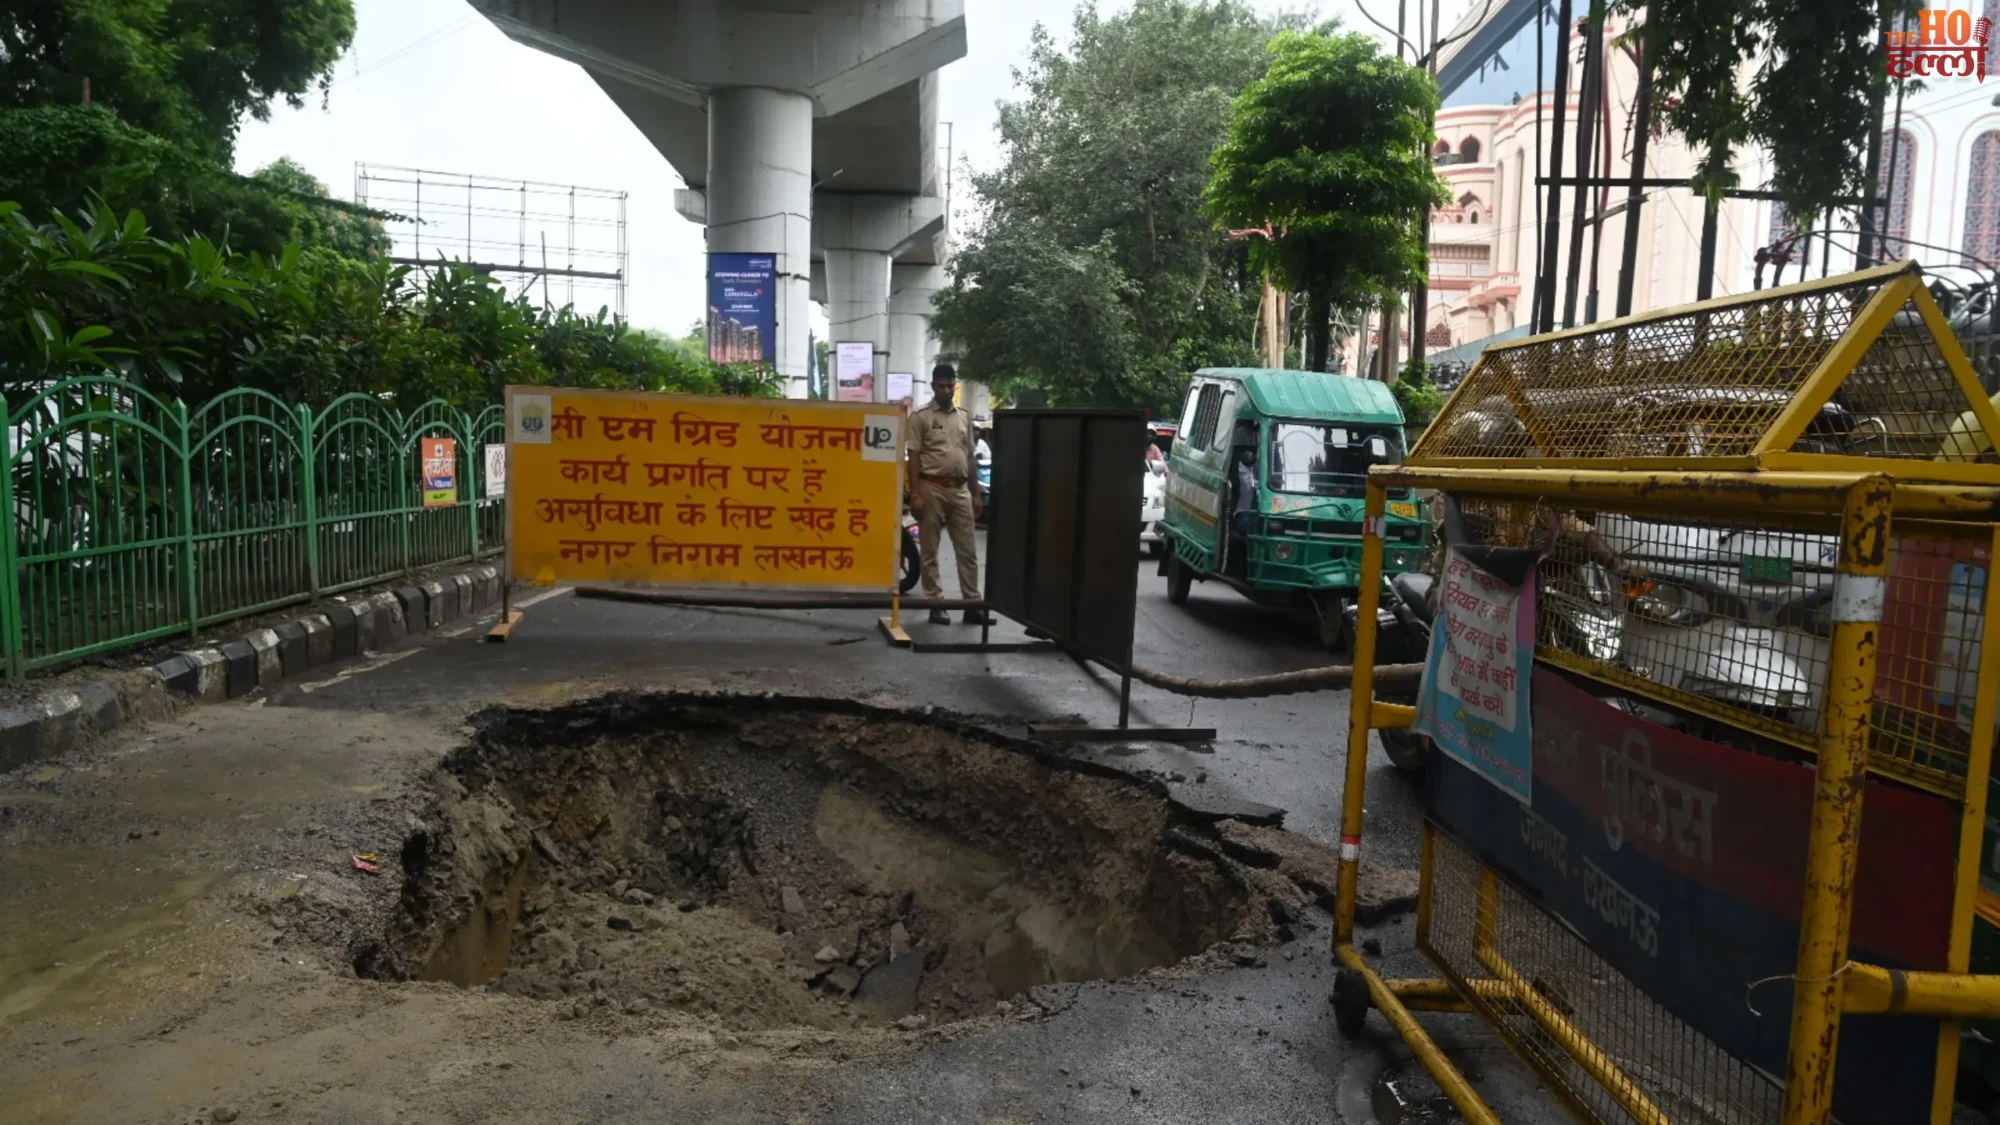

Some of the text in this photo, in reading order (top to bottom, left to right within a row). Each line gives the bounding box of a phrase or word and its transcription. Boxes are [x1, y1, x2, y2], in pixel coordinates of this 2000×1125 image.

[598, 416, 657, 442] एम
[670, 411, 740, 446] ग्रिड
[759, 414, 864, 451] योजना
[559, 454, 630, 486] कार्य
[643, 457, 732, 491] प्रगति
[742, 467, 790, 492] पर
[535, 493, 663, 531] असुविधा
[676, 494, 706, 526] के
[716, 497, 776, 530] लिए
[786, 498, 838, 540] खेद
[559, 535, 854, 571] नगर निगम लखनऊ
[1600, 728, 1717, 863] पुलिस
[1582, 854, 1660, 957] लखनऊ
